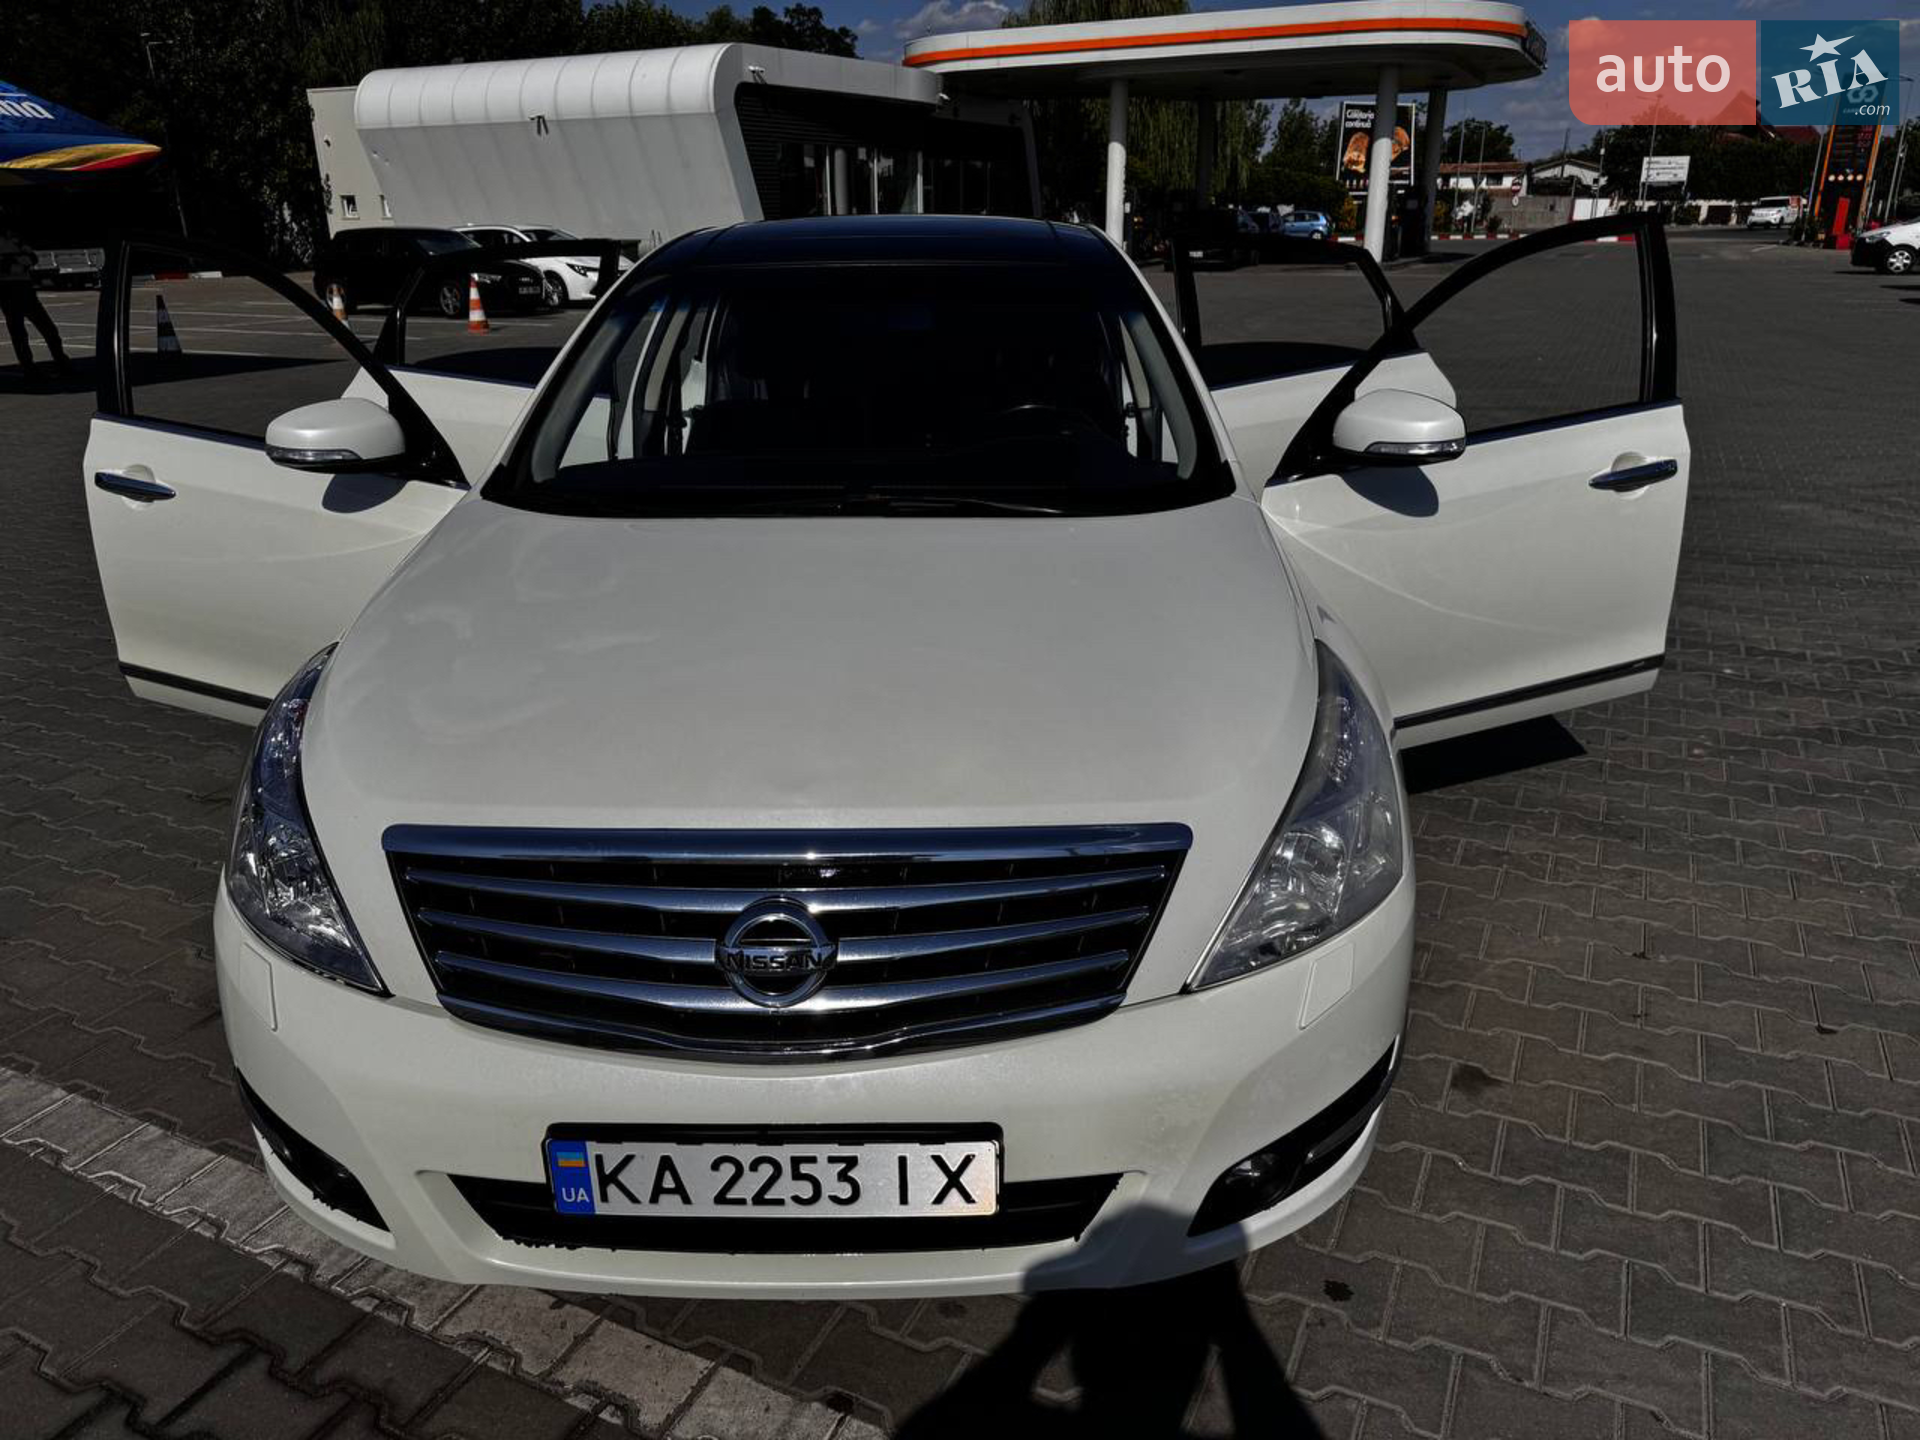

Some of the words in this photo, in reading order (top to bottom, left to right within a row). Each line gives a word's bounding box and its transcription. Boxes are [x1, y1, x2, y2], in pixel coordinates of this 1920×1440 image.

[726, 949, 824, 970] NISSAN
[594, 1154, 692, 1205] KA
[710, 1155, 861, 1206] 2253
[898, 1154, 976, 1205] IX
[561, 1187, 589, 1203] UA
